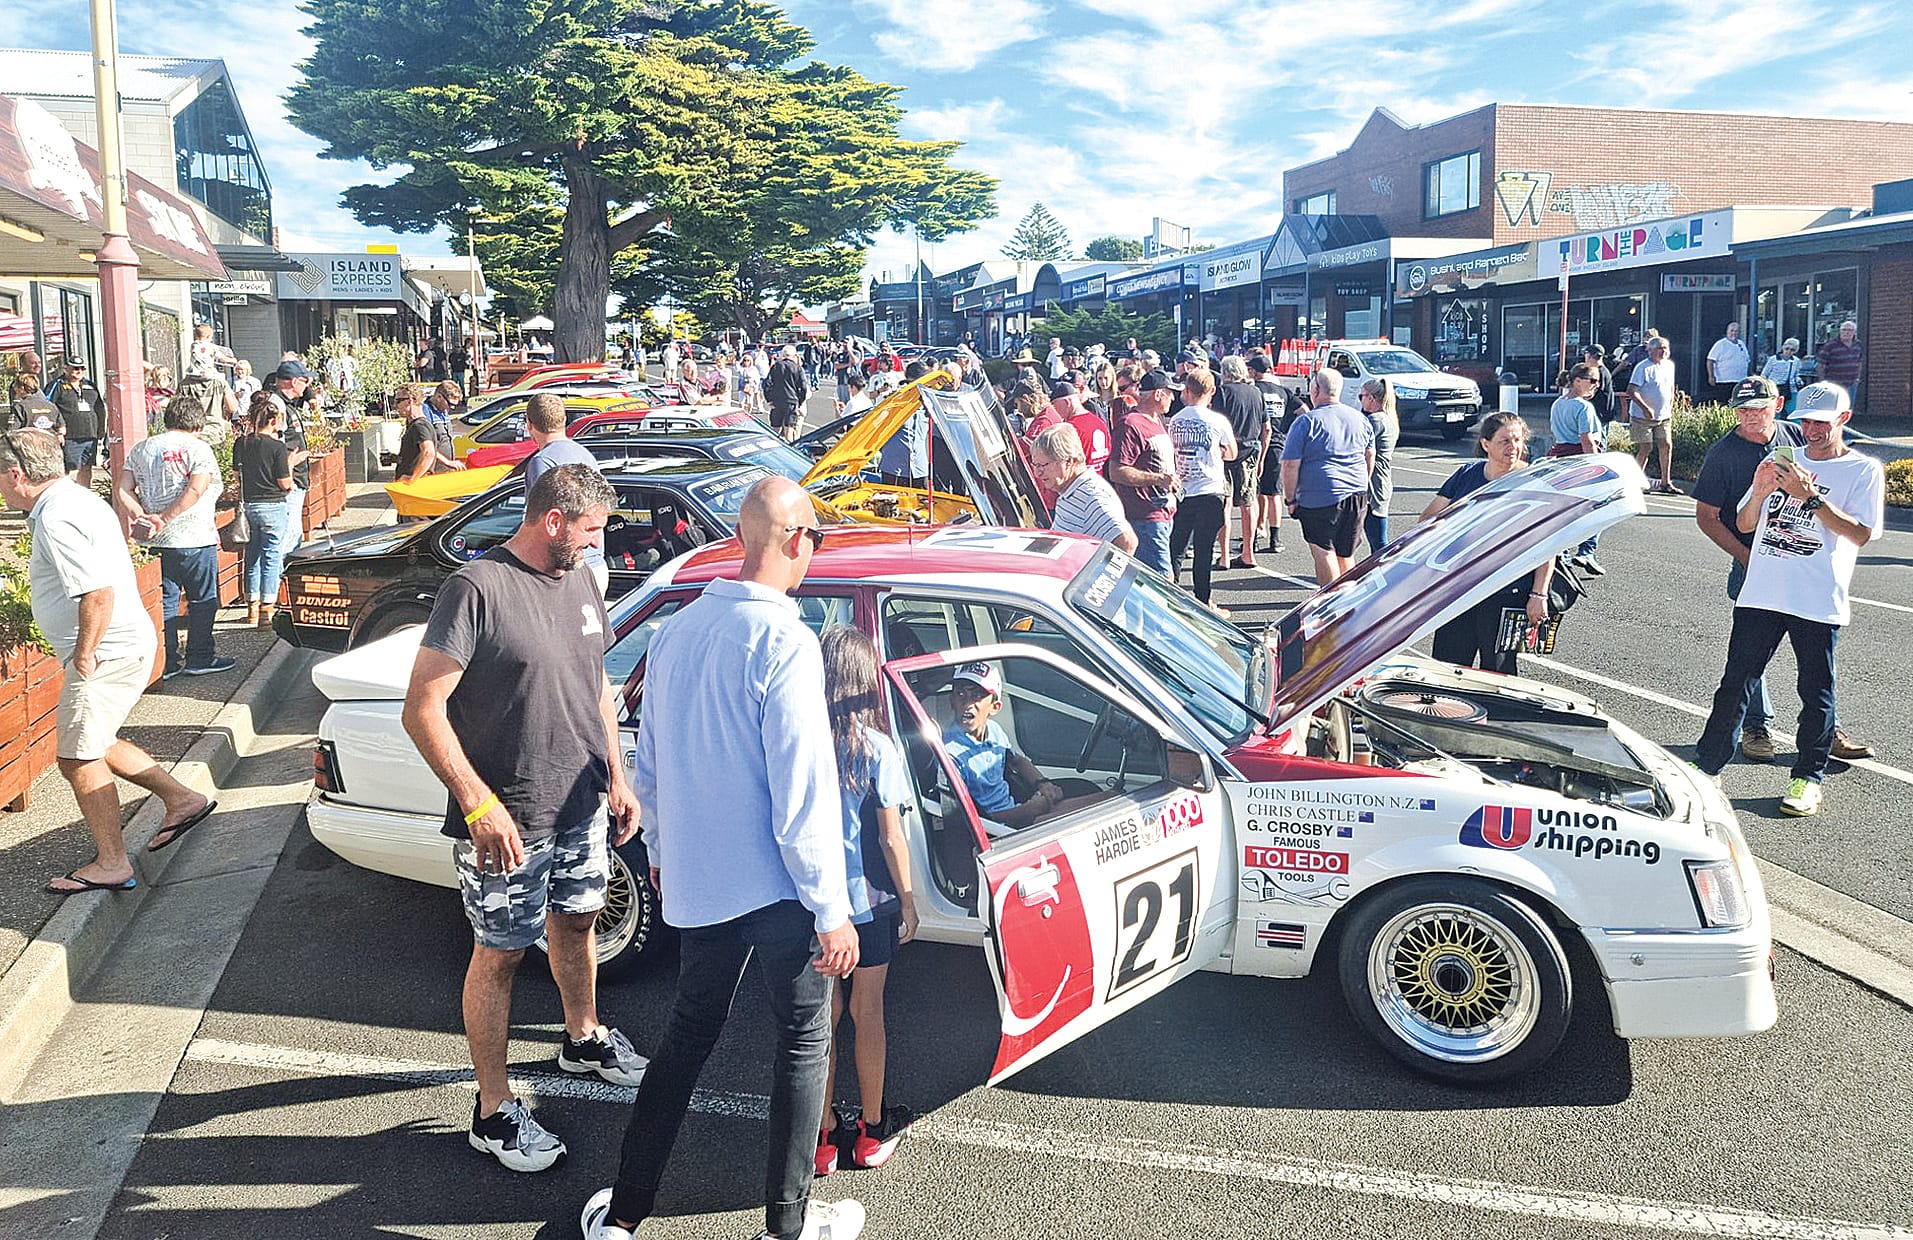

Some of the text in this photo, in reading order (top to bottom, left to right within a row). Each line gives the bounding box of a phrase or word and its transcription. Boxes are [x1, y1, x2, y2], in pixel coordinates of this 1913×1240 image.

[1559, 218, 1703, 265] TURN THE PAGE
[331, 260, 392, 273] ISLAND
[1510, 252, 1529, 263] Bar
[1207, 258, 1252, 278] ISLAND GLOW
[331, 273, 392, 286] EXPRESS
[295, 595, 352, 608] DUNLOP
[300, 608, 349, 626] Castrol
[1247, 786, 1419, 811] JOHN BILLINGTON N.Z.
[1247, 803, 1356, 823] CHRIS CASTLE
[1537, 808, 1618, 831] union
[1094, 818, 1138, 848] JAMES
[1247, 819, 1334, 837] G. CROSBY
[1096, 834, 1141, 866] HARDIE
[1273, 836, 1321, 850] FAMOUS
[1533, 827, 1661, 865] shipping
[1251, 848, 1342, 871] TOLEDO
[1278, 871, 1315, 883] TOOLS
[1115, 862, 1194, 991] 21
